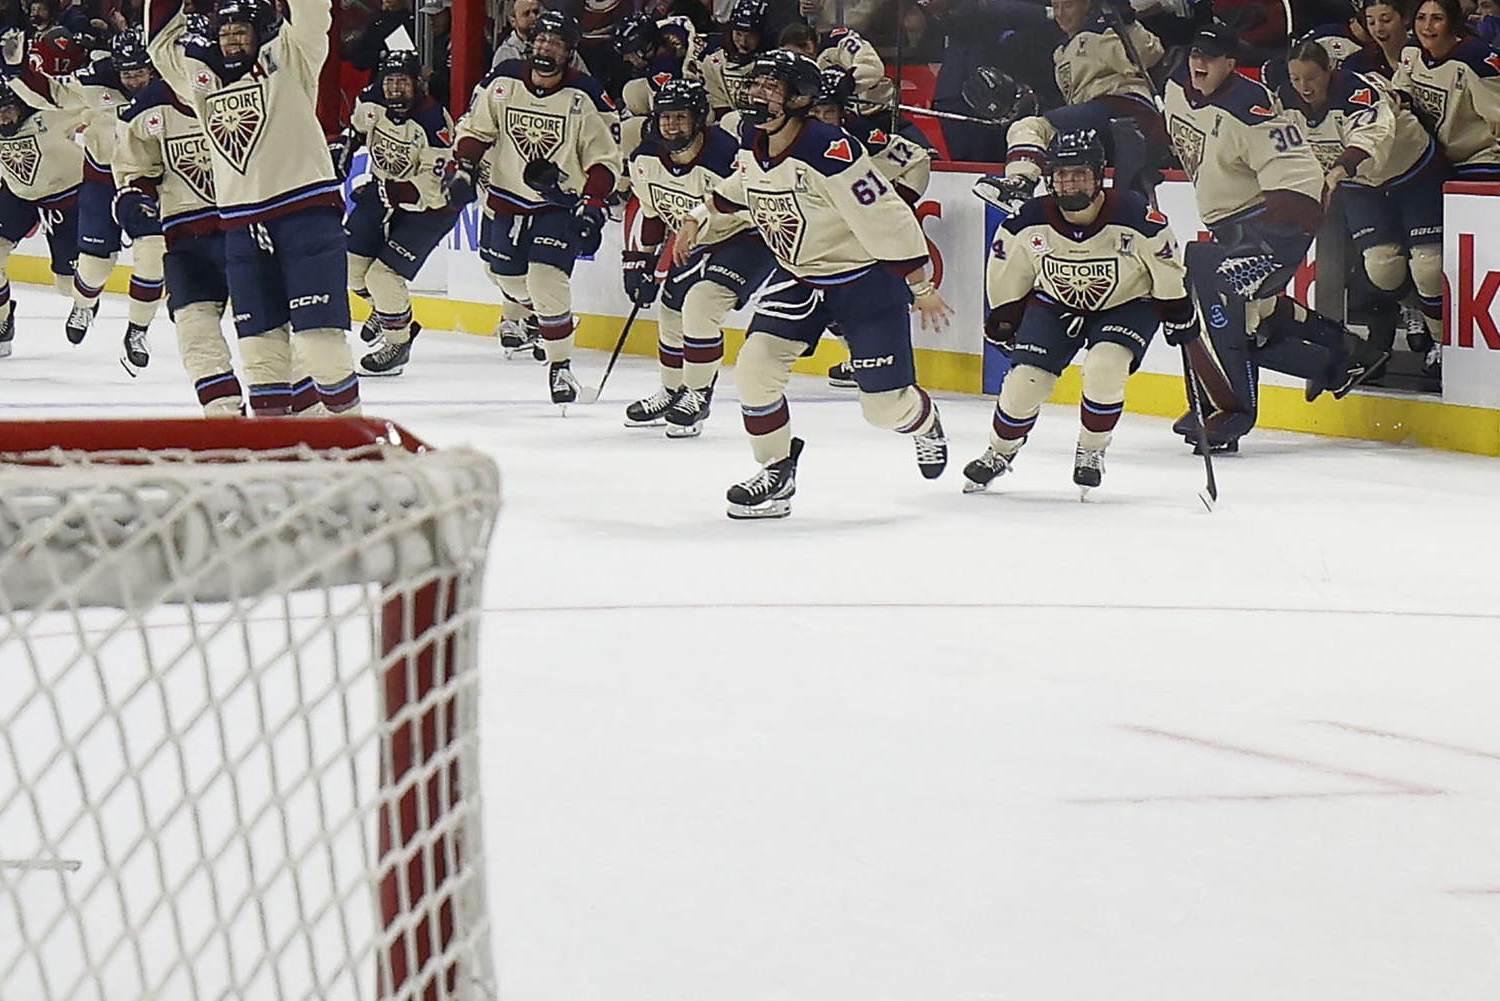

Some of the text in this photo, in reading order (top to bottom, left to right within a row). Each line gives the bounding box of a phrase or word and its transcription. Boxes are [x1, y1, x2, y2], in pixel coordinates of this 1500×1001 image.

[509, 112, 561, 131] VICTOIRE
[1268, 124, 1304, 153] 30
[851, 169, 888, 206] 61
[388, 240, 417, 262] CCM
[533, 236, 568, 250] CCM
[1047, 263, 1113, 279] VICTOIRE
[289, 293, 329, 310] CCM
[1101, 324, 1147, 346] BAUER
[852, 354, 894, 369] CCM
